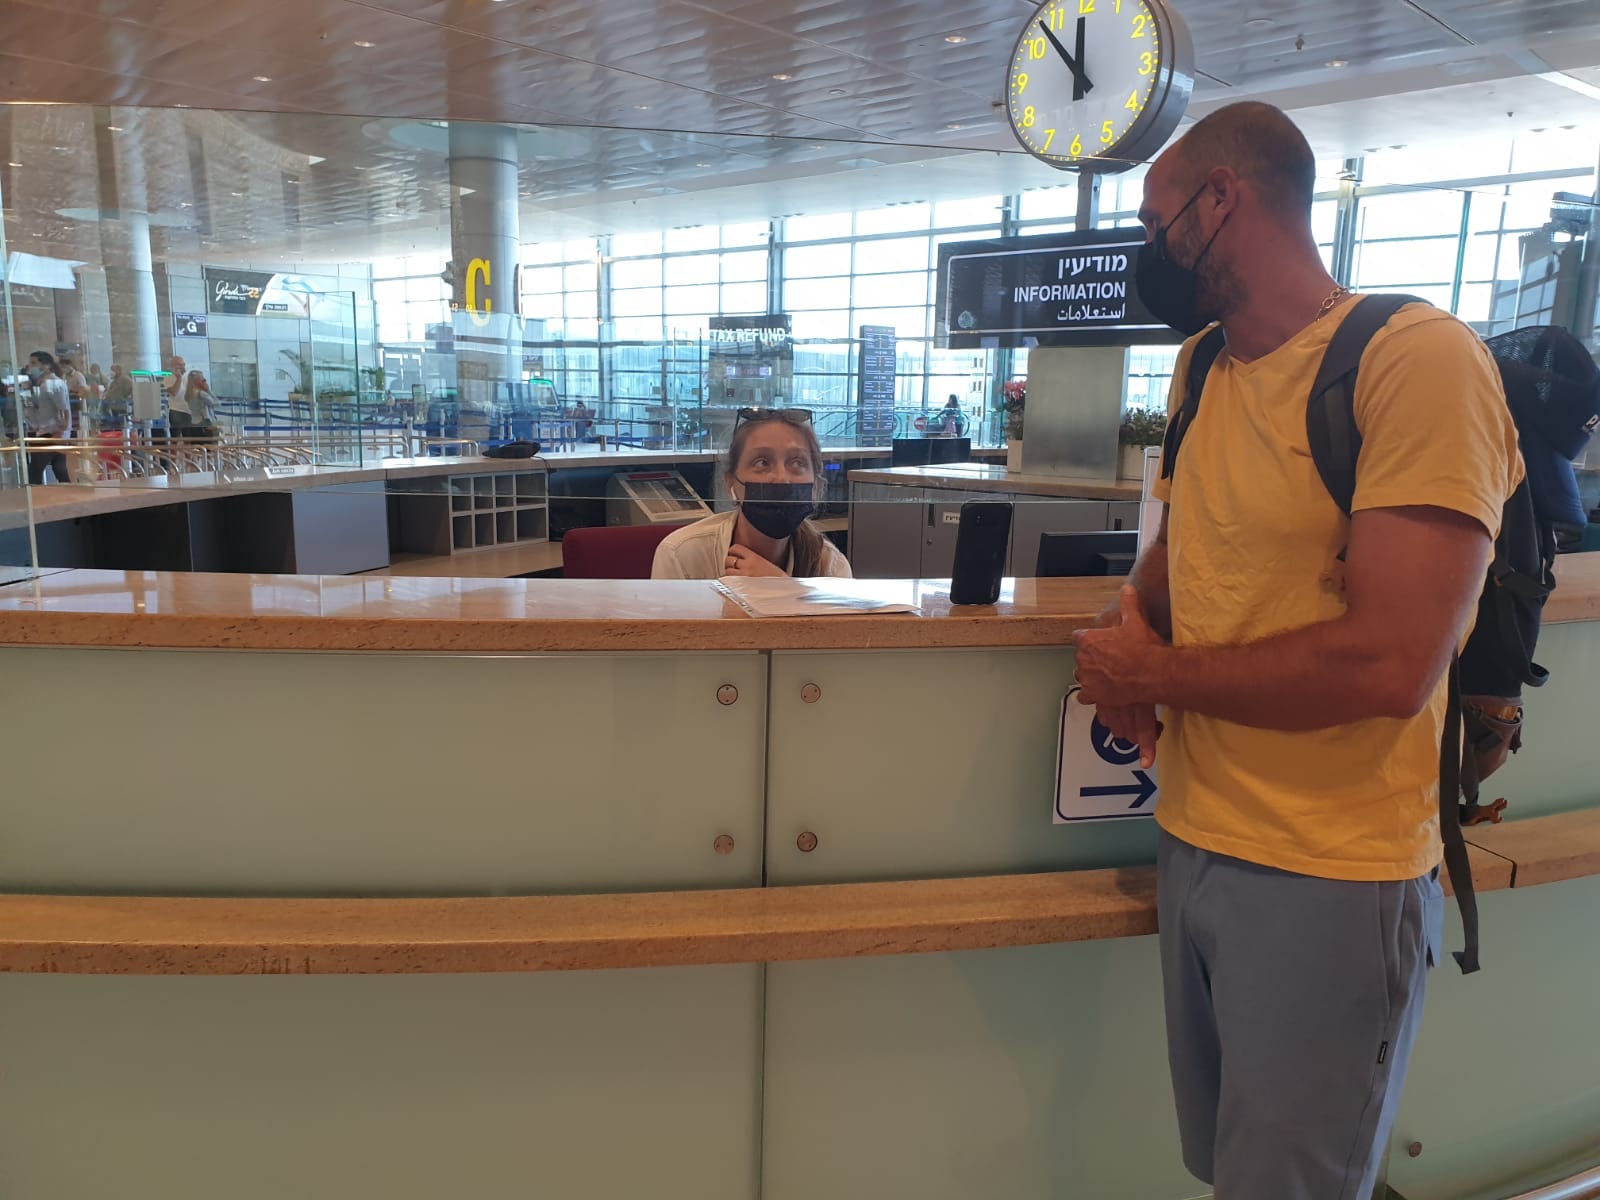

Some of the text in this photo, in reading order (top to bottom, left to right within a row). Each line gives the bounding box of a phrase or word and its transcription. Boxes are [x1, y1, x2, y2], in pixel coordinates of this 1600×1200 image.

[1079, 0, 1095, 14] 12
[1114, 0, 1121, 14] 1
[1049, 8, 1065, 31] 11
[1131, 14, 1146, 38] 2
[1028, 36, 1046, 60] 10
[1138, 52, 1152, 75] 3
[1016, 73, 1029, 95] 9
[1124, 89, 1138, 112] 4
[1023, 105, 1035, 127] 8
[1044, 129, 1056, 151] 7
[1100, 120, 1113, 143] 5
[1070, 133, 1082, 156] 6
[1057, 254, 1128, 280] מודיעין
[466, 258, 490, 327] C
[1014, 281, 1126, 303] INFORMATION
[1057, 302, 1126, 321] استعلامات
[187, 322, 197, 332] G
[709, 327, 786, 342] TAX REFUND
